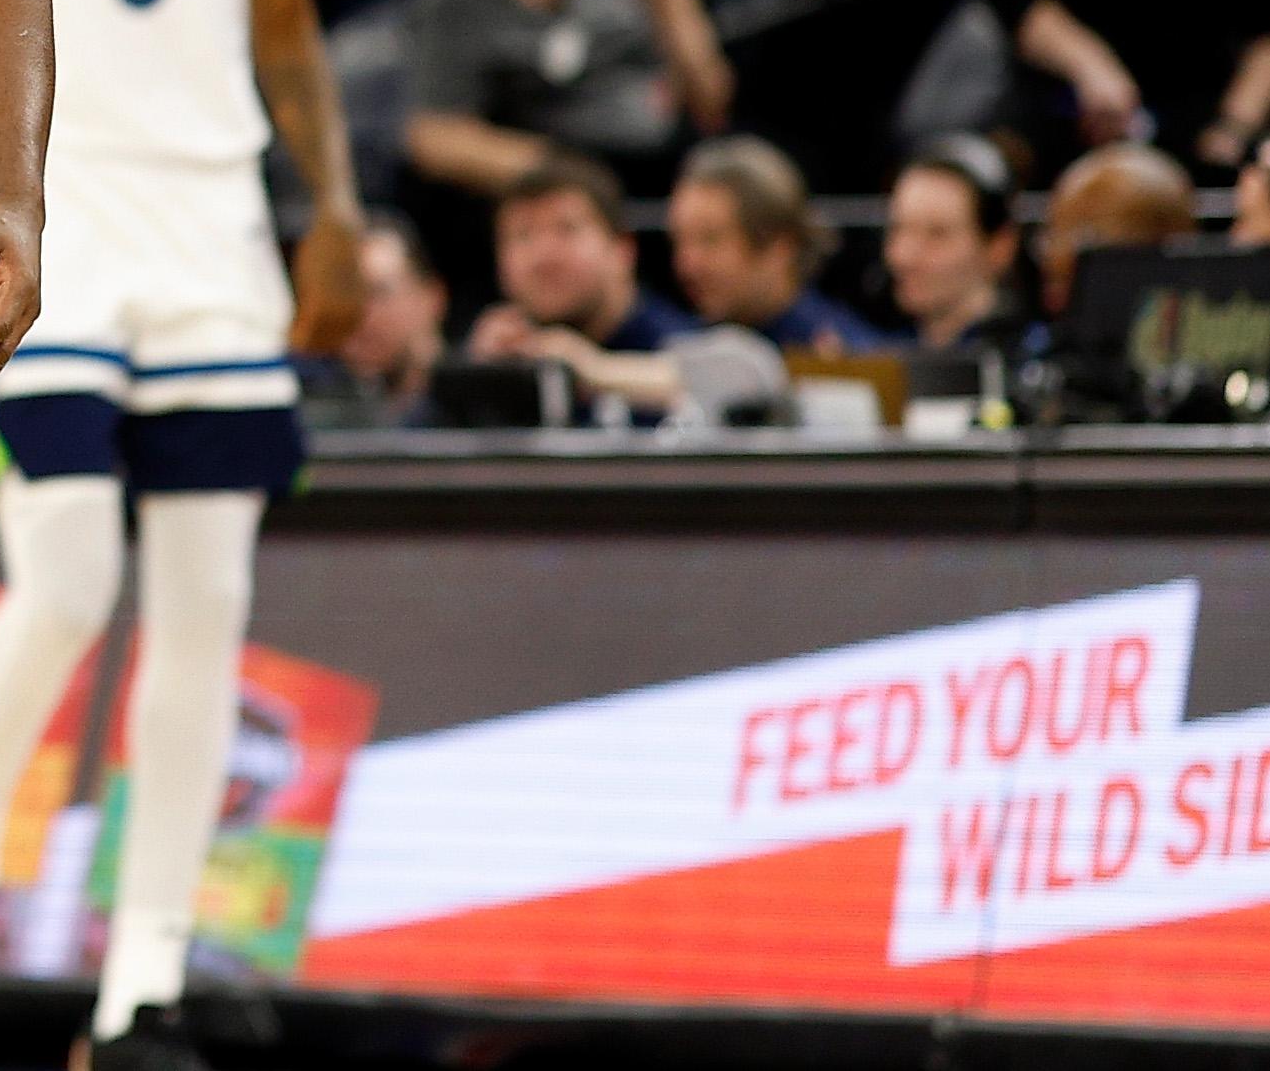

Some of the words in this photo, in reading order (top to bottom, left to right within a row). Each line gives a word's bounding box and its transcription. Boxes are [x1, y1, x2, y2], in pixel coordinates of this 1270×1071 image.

[732, 682, 923, 807] FEED
[947, 635, 1152, 767] YOUR
[941, 771, 1143, 912] WILD
